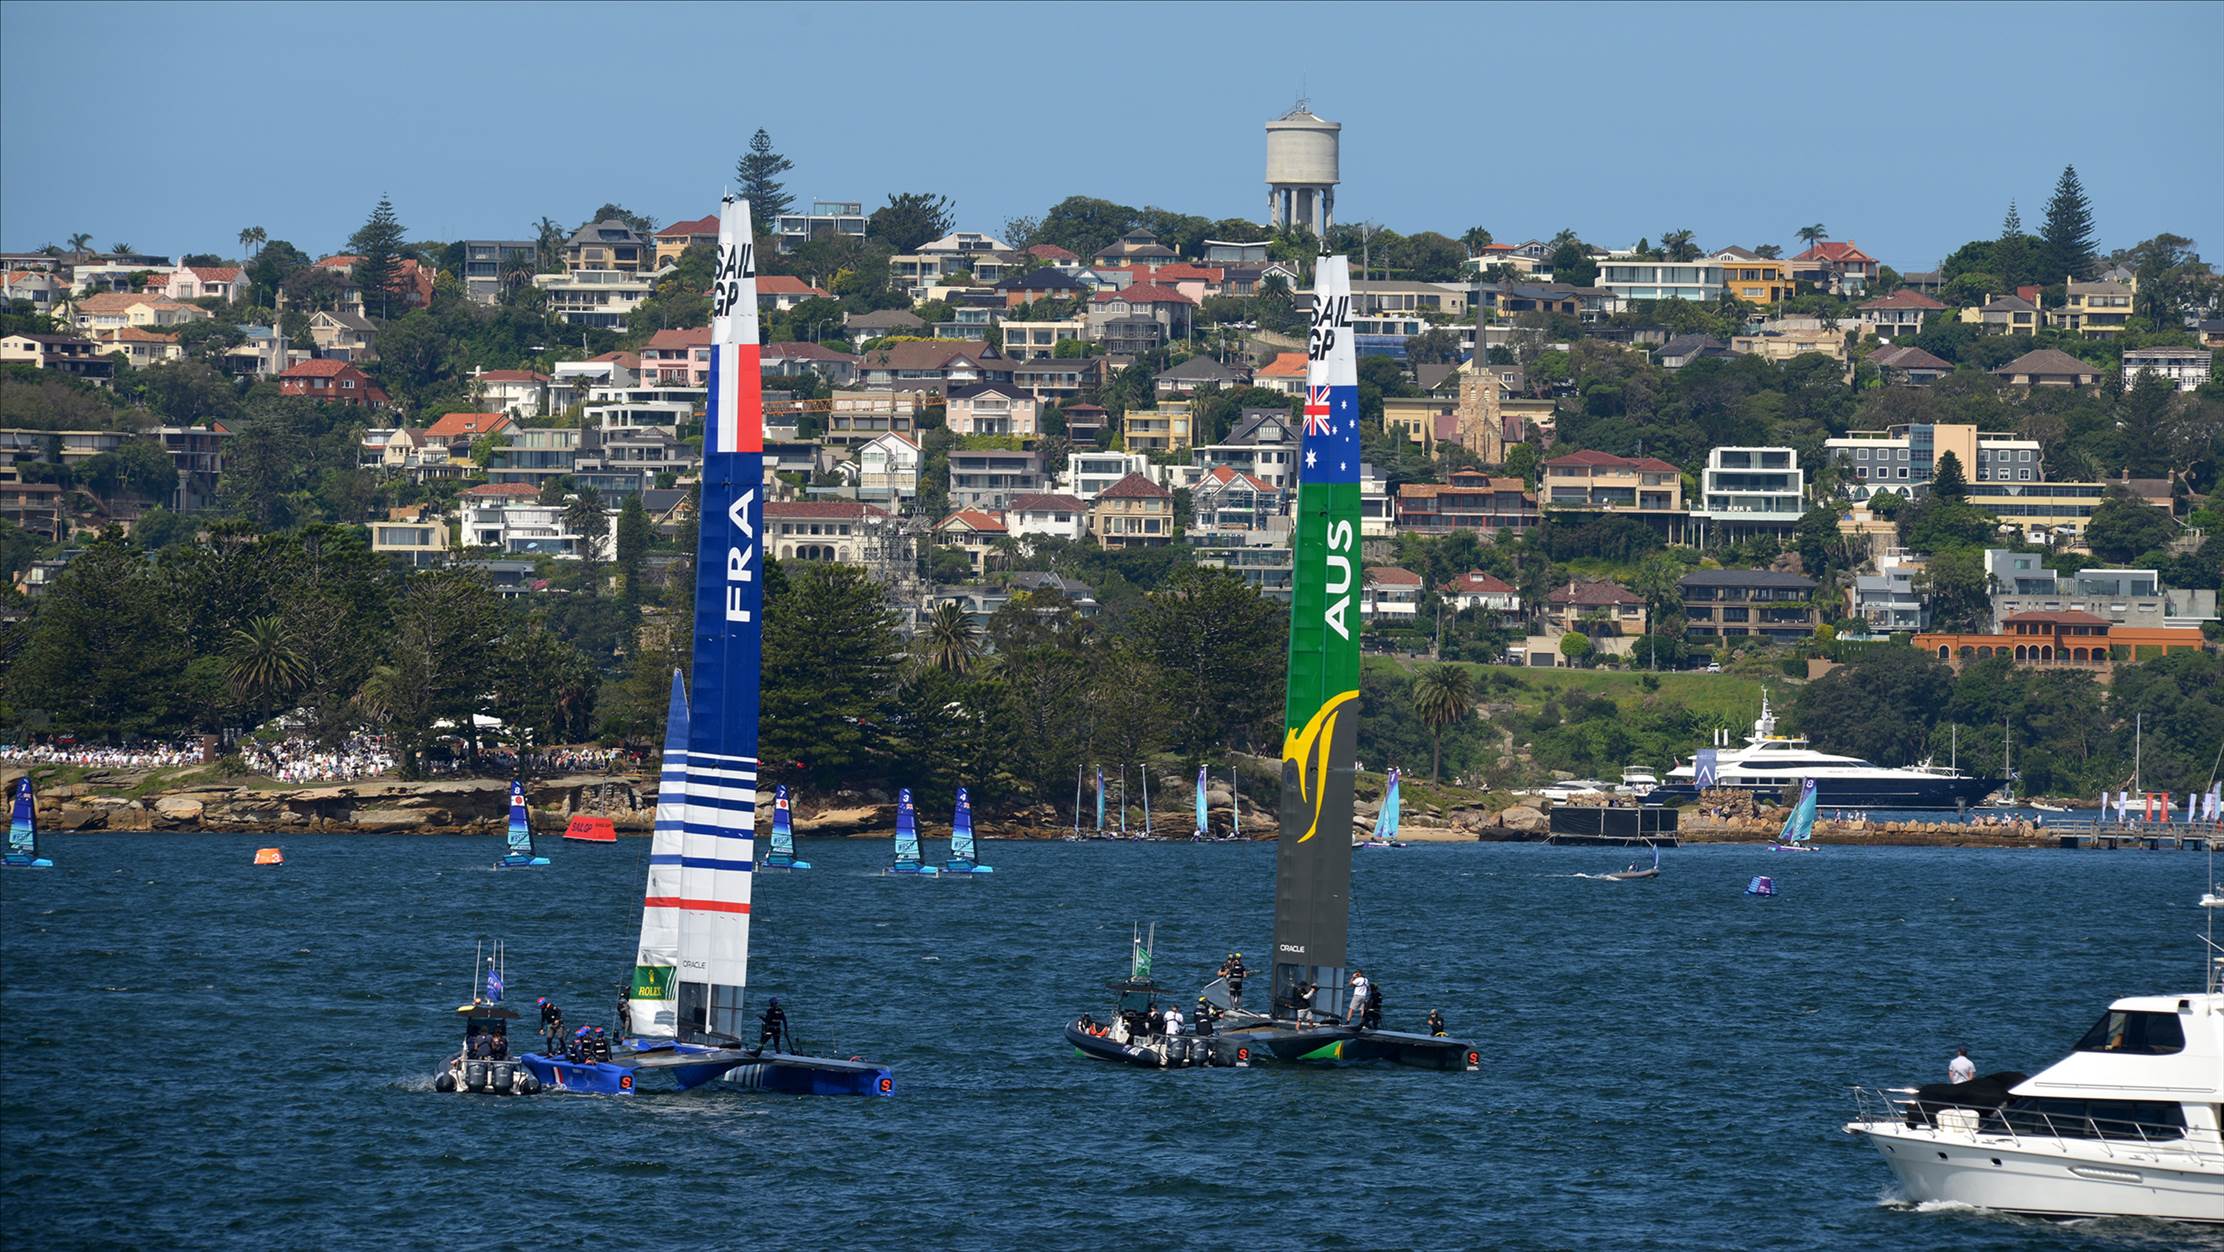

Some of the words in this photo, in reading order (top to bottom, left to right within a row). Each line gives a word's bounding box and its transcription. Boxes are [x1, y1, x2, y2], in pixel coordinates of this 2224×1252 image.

[715, 243, 755, 280] SAIL
[713, 281, 739, 318] GP
[1311, 294, 1353, 328] SAIL
[1308, 328, 1335, 361] GP
[726, 488, 754, 623] FRA
[1324, 519, 1353, 641] AUS
[682, 959, 707, 970] ORACLE
[1280, 944, 1305, 953] ORACLE
